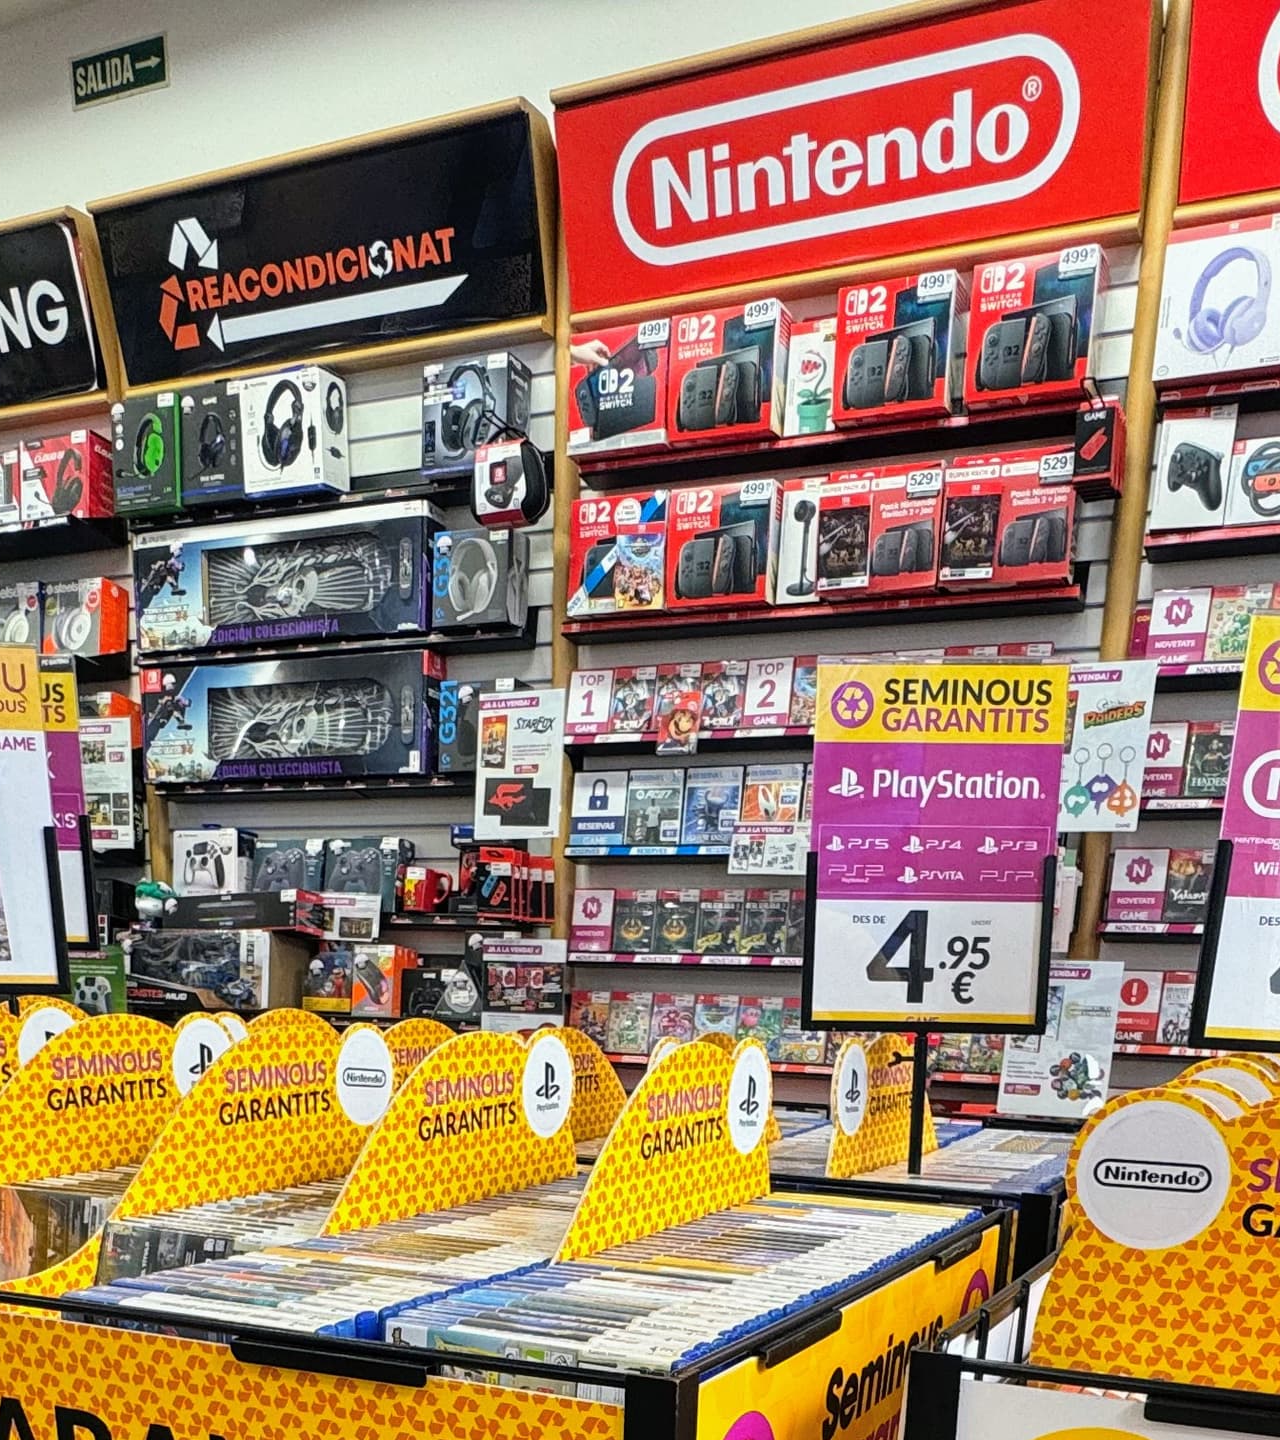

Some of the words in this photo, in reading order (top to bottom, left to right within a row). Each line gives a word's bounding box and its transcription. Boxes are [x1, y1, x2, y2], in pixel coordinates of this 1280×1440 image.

[75, 53, 134, 97] SALIDA
[651, 87, 1030, 231] Nintendo
[980, 300, 1021, 312] SWITCH
[846, 322, 884, 334] SWITCH
[678, 349, 714, 360] SWITCH
[600, 400, 633, 411] SWITCH
[1084, 411, 1106, 422] GAME
[676, 521, 711, 530] SWITCH
[255, 618, 339, 639] COLECCIONISTA
[1155, 638, 1195, 649] NOVETATS
[757, 663, 784, 675] TOP
[1079, 673, 1109, 681] VENDA!
[580, 675, 605, 686] TOP
[757, 680, 776, 708] 2
[884, 678, 1053, 707] SEMINOUS
[581, 690, 595, 716] 1
[754, 715, 777, 725] GAME
[880, 707, 1049, 734] GARANTITS
[575, 724, 597, 733] GAME
[259, 760, 342, 776] COLECCIONISTA
[873, 769, 1040, 808] PlayStation
[578, 822, 615, 830] RESERVAS
[848, 838, 889, 850] PS5
[926, 840, 962, 850] PS4
[1000, 841, 1038, 851] PS3
[828, 864, 885, 876] PS2
[979, 870, 1035, 882] PSP
[1253, 862, 1280, 876] Wii
[853, 915, 871, 924] DES
[873, 915, 885, 924] DE
[1120, 912, 1148, 920] GAME
[951, 970, 978, 1005] €
[1116, 1032, 1143, 1040] GAME
[52, 1049, 163, 1080] SEMINOUS
[224, 1061, 328, 1093] SEMINOUS
[344, 1072, 384, 1085] Nintendo
[47, 1077, 167, 1111] GARANTITS
[423, 1071, 515, 1108] SEMINOUS
[218, 1090, 331, 1126] GARANTITS
[646, 1082, 722, 1123] SEMINOUS
[418, 1103, 517, 1142] GARANTITS
[640, 1116, 723, 1160] GARANTITS
[1102, 1163, 1200, 1188] Nintendo
